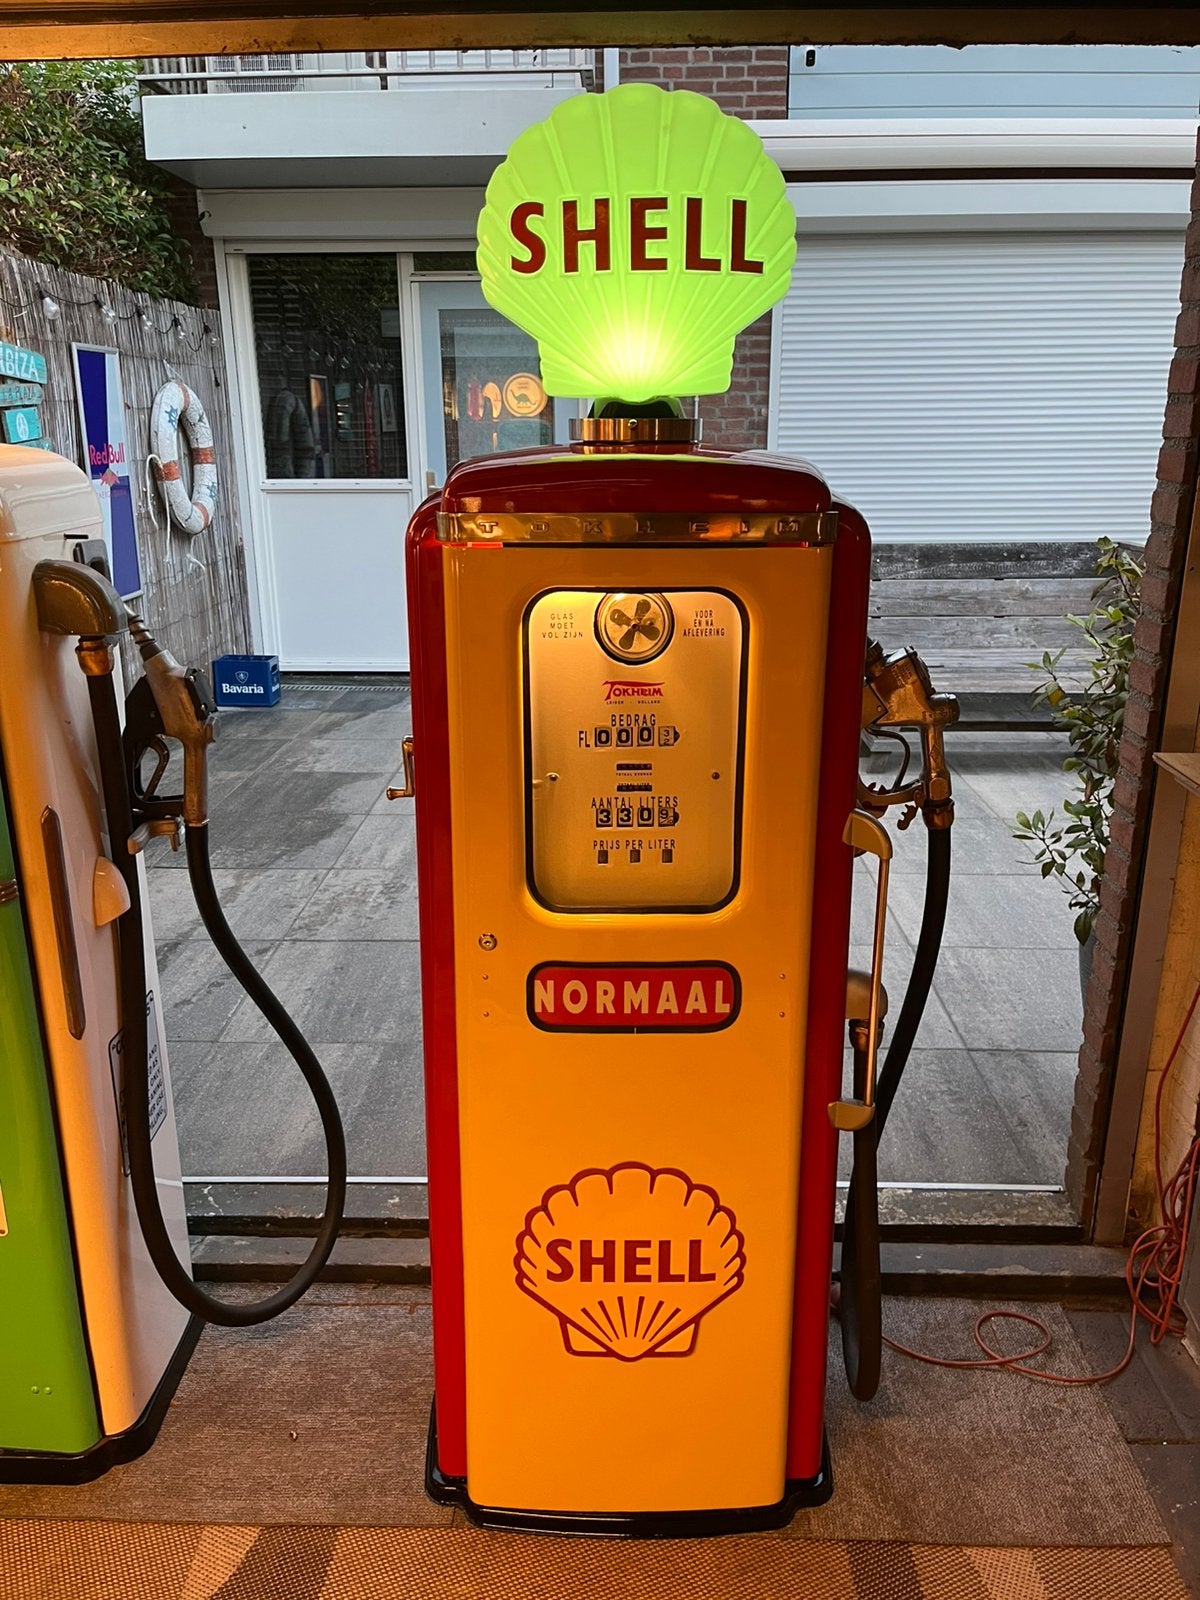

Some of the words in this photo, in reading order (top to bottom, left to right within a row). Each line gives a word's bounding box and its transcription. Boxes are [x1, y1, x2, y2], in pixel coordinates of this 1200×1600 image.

[510, 197, 765, 275] SHELL
[89, 443, 108, 465] Red
[108, 442, 125, 464] Bull
[550, 613, 575, 621] GLAS
[695, 610, 714, 619] VOOR
[550, 622, 575, 630] MOET
[694, 619, 703, 628] EN
[542, 631, 559, 639] VOL
[563, 631, 584, 639] ZIJN
[683, 628, 725, 638] AFLEVERING
[222, 683, 264, 694] Bavaria
[602, 680, 665, 701] TOKHEIM
[611, 713, 656, 727] BEDRAG
[578, 730, 591, 748] FL
[591, 797, 633, 809] AANTAL
[639, 796, 678, 808] LITERS
[593, 840, 621, 850] PRIJS
[625, 839, 643, 850] PER
[648, 839, 676, 850] LITER
[533, 979, 731, 1015] NORMAAL
[546, 1238, 716, 1283] SHELL
